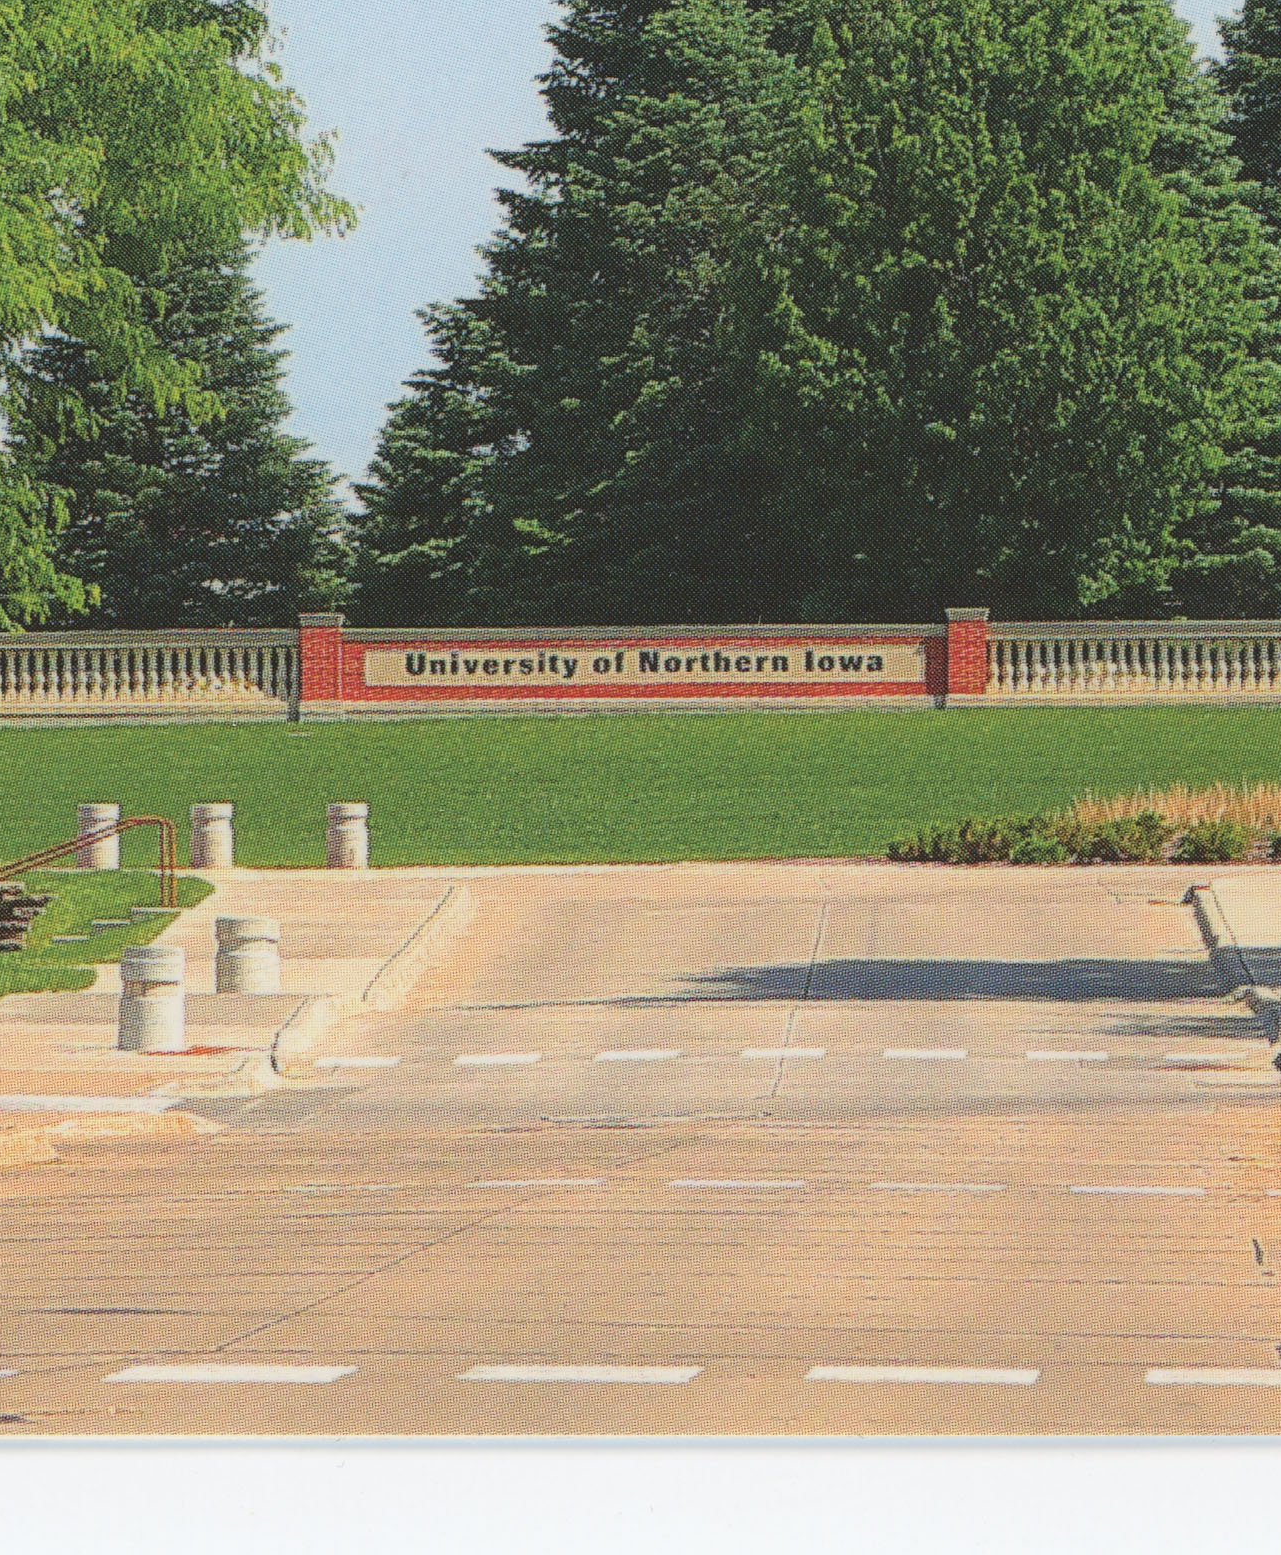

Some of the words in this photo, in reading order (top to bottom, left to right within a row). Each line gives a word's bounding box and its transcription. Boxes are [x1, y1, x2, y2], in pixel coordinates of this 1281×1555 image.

[404, 652, 579, 679] University
[593, 650, 626, 674] of
[638, 650, 790, 674] Northern
[805, 650, 885, 674] Iowa
